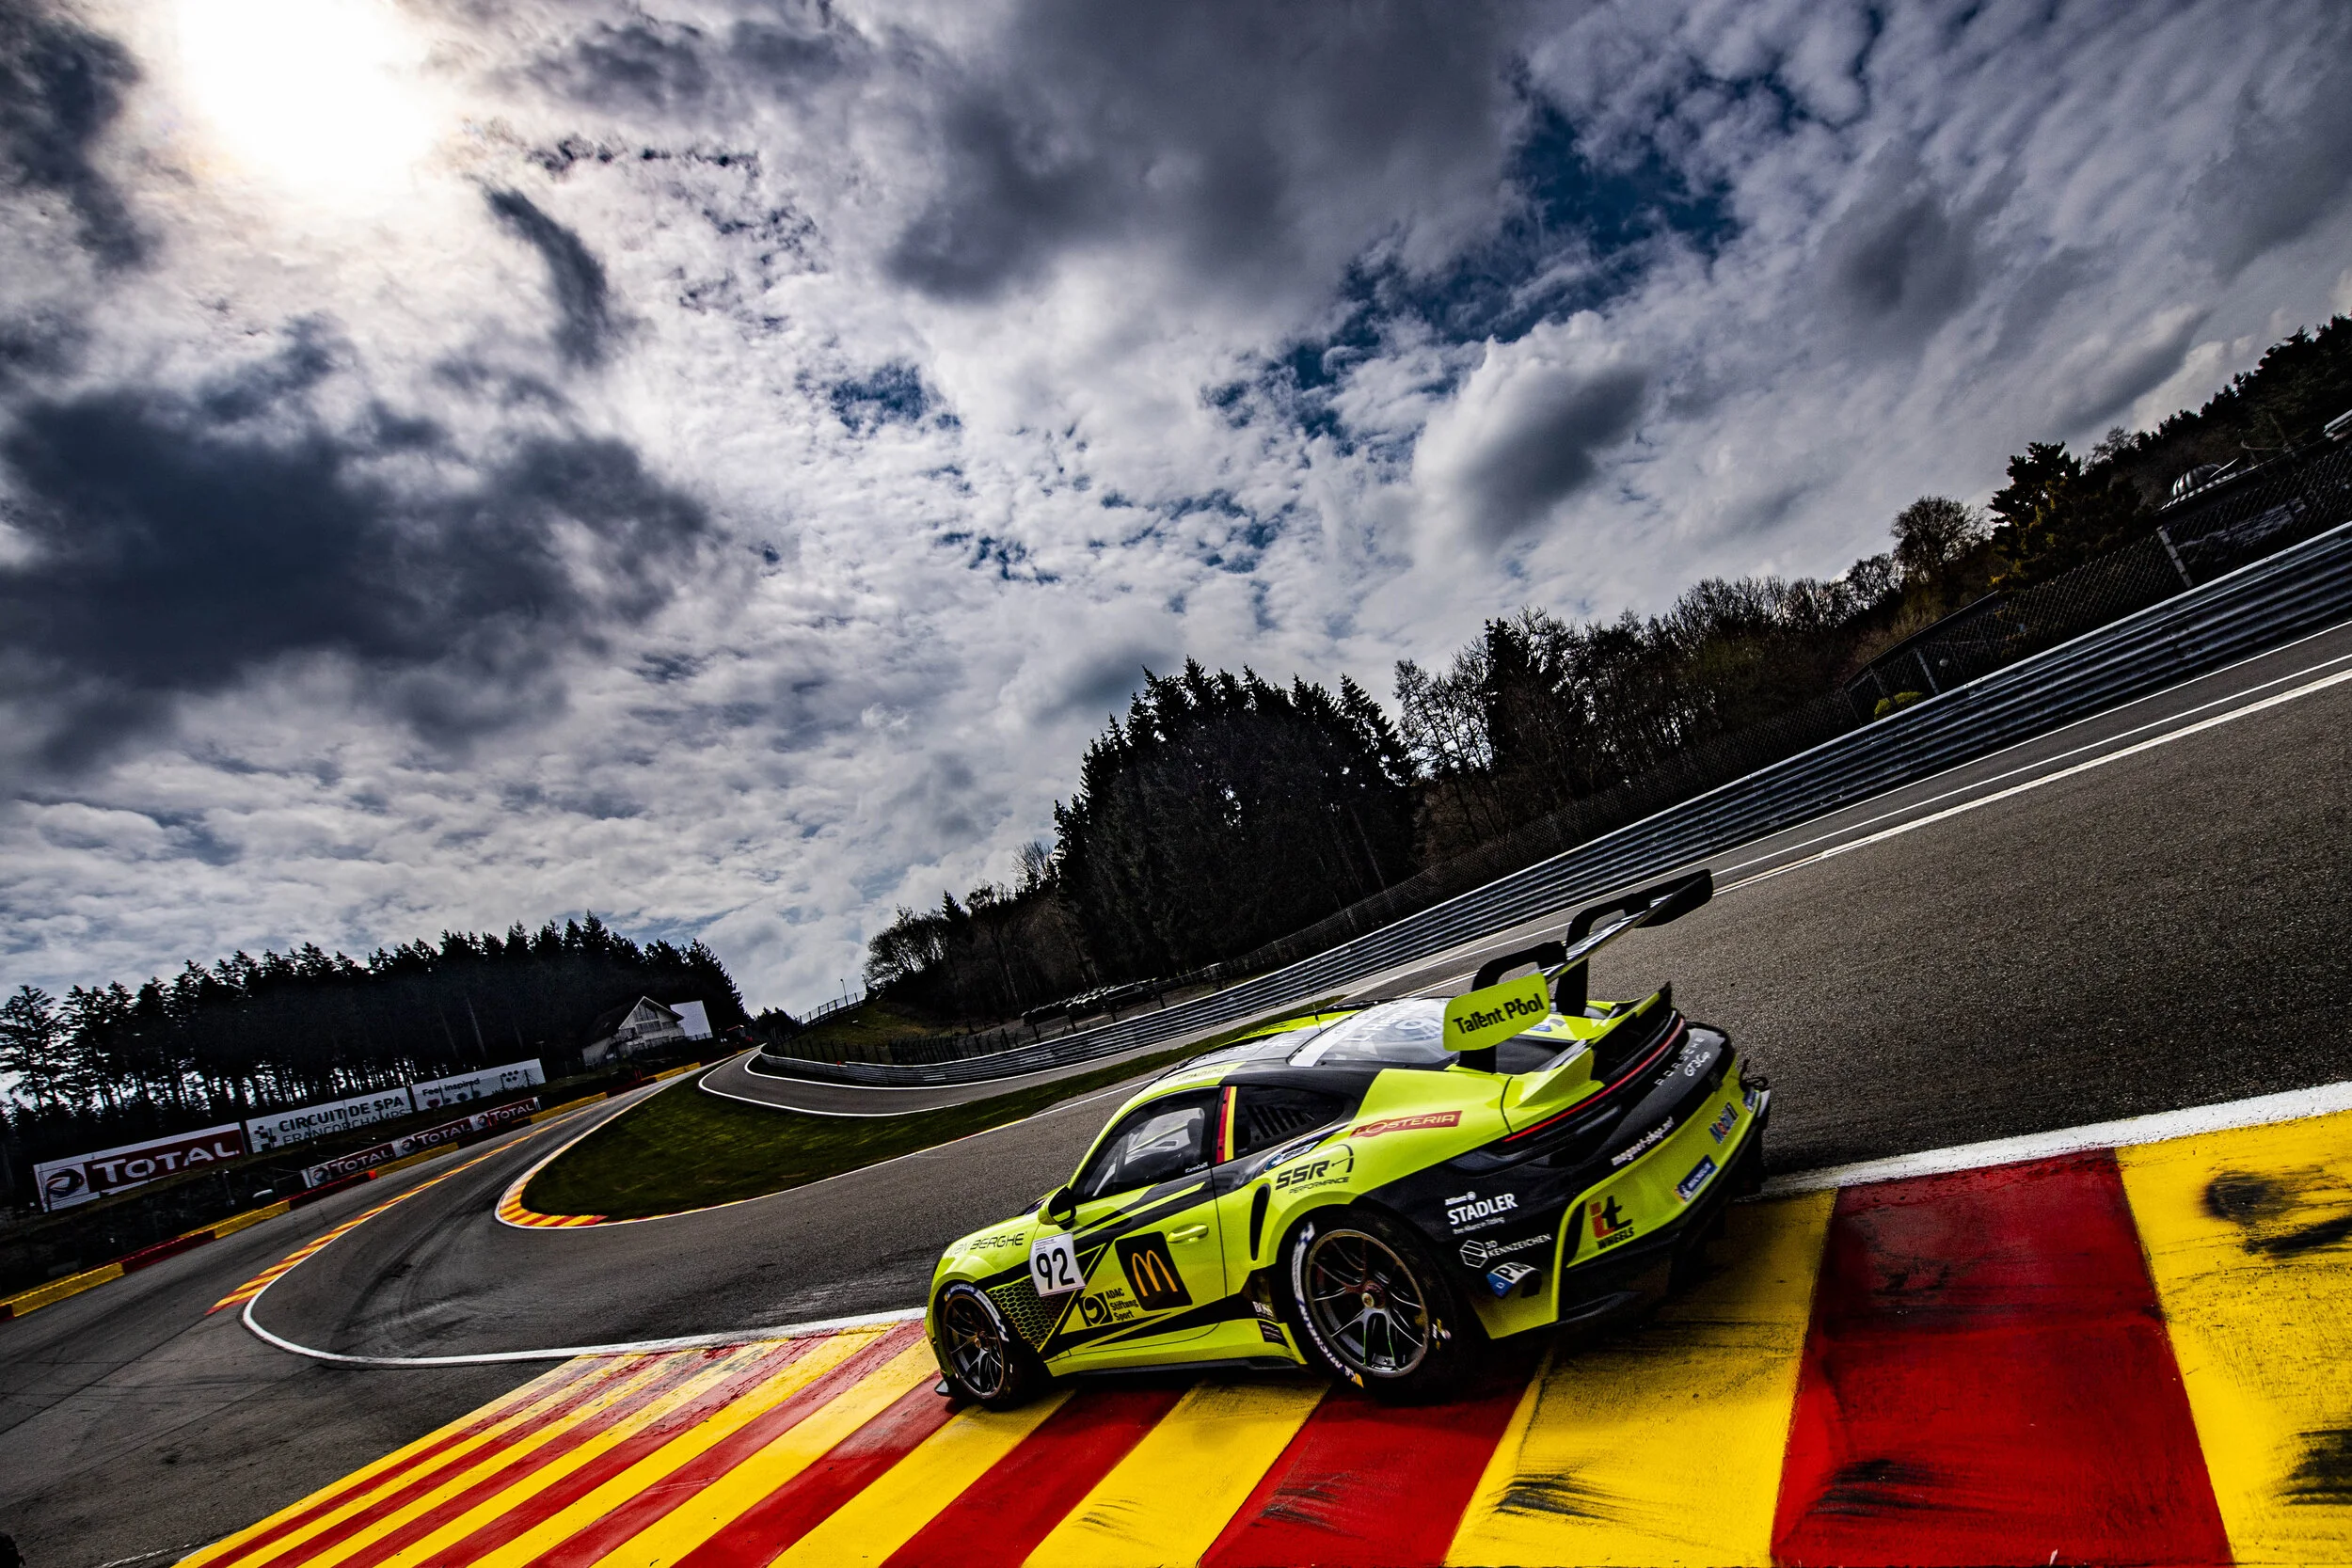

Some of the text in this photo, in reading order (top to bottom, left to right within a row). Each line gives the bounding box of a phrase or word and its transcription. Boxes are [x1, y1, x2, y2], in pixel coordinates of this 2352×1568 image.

[1655, 1037, 1705, 1085] PORSCHE
[278, 1096, 405, 1132] CIRCUIT DE SPA
[490, 1103, 535, 1121] TOTAL
[416, 1123, 471, 1145] TOTAL
[92, 1142, 238, 1183] TOTAL
[330, 1148, 392, 1174] TOTAL
[1276, 1160, 1330, 1191] SSR
[1289, 1177, 1350, 1196] PERFORMANCE
[1447, 1193, 1518, 1225] STADLER
[970, 1232, 1025, 1250] BERGHE
[1486, 1240, 1498, 1249] 3D
[1488, 1233, 1552, 1257] KENNZEICHEN
[1597, 1227, 1634, 1249] WHEELS
[1036, 1247, 1075, 1290] 92
[1105, 1288, 1124, 1299] ADAC
[1110, 1299, 1139, 1311] Stiftung
[1114, 1309, 1135, 1322] Sport
